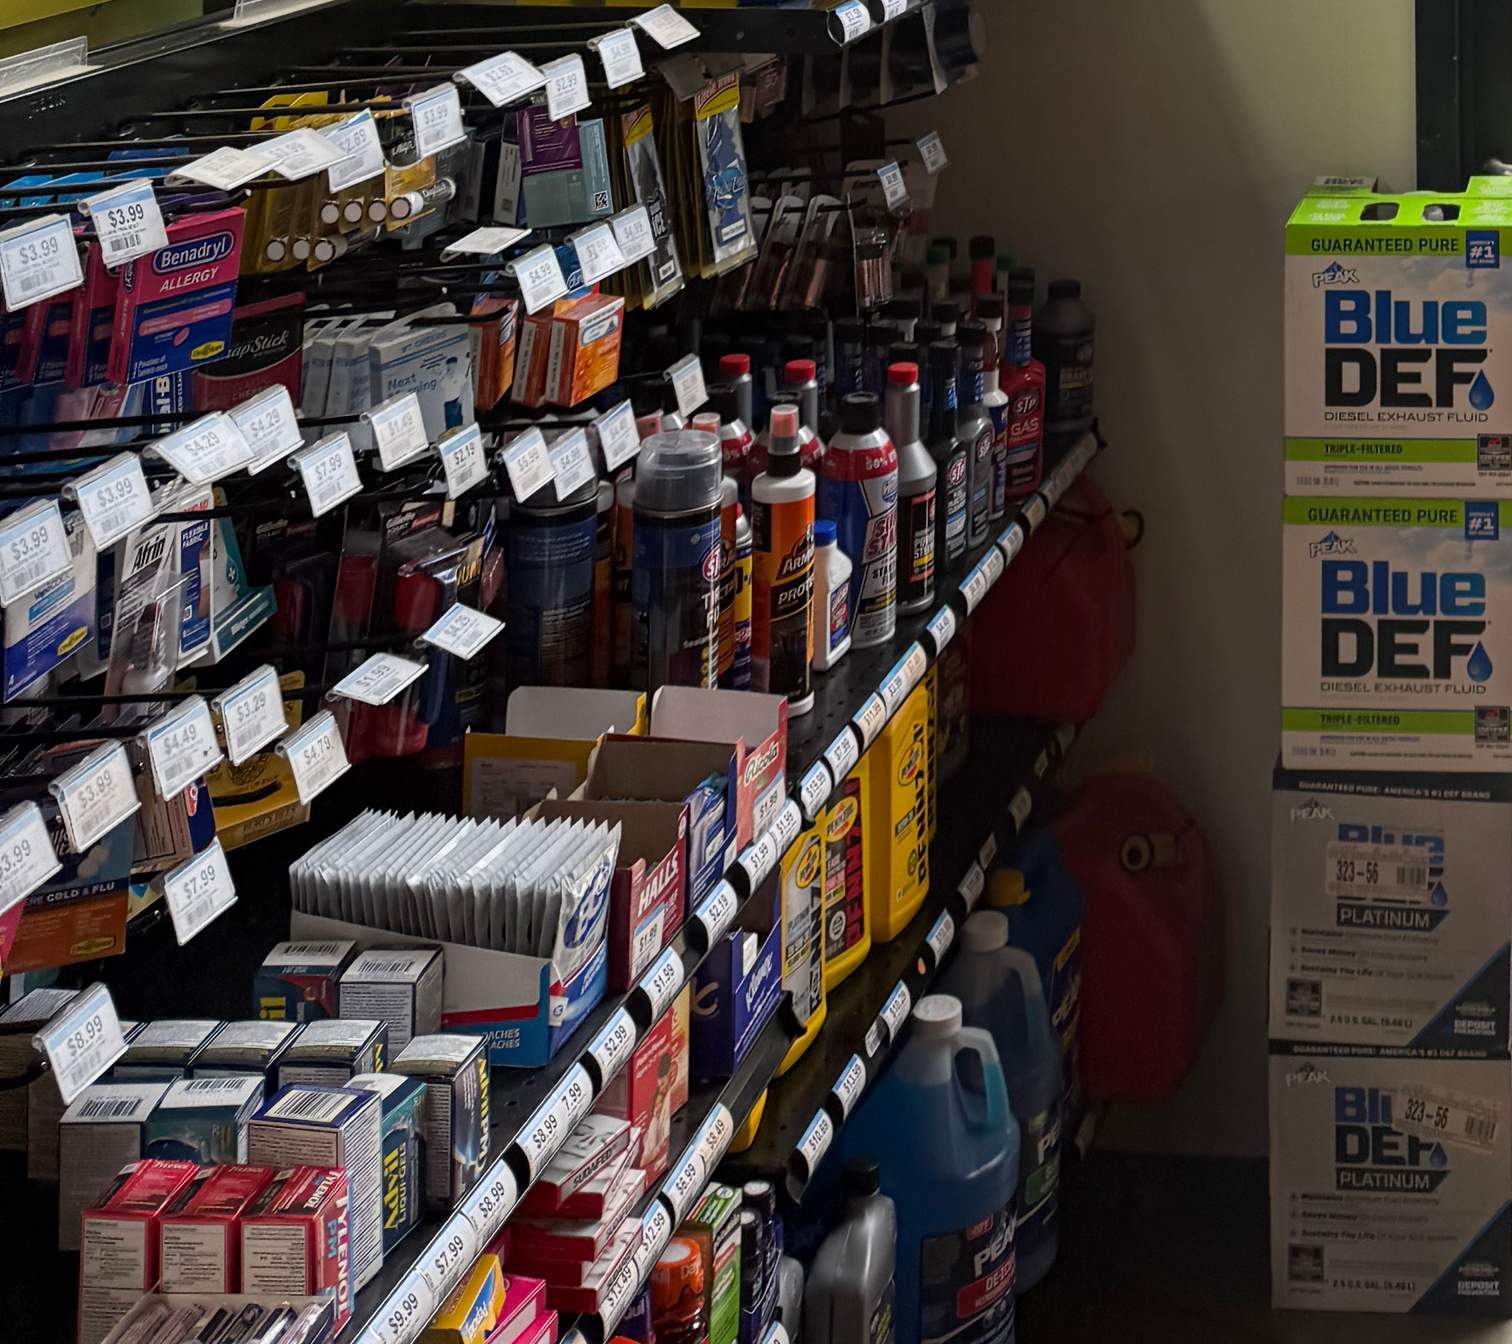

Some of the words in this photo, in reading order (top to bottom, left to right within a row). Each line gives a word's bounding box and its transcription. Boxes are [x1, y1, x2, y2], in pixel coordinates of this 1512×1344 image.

[107, 203, 145, 228] $3.99
[19, 236, 59, 265] $3.99
[161, 238, 226, 267] Benadryl
[1311, 238, 1413, 253] GUARANTEED
[1418, 238, 1459, 252] PURE
[1469, 245, 1495, 259] #1
[159, 266, 219, 293] ALLERGY
[1312, 268, 1360, 288] PEAK
[1324, 290, 1488, 345] Blue
[1324, 348, 1488, 408] DEF
[1324, 411, 1374, 422] DIESEL
[1377, 412, 1444, 423] EXHAUST
[1447, 412, 1489, 423] FLUID
[1324, 444, 1403, 455] TRIPLE-FILTERED
[314, 454, 343, 481] $7.99
[96, 477, 134, 507] $3.99
[1308, 508, 1411, 523] GUARANTEED
[1416, 509, 1458, 524] PURE
[1469, 517, 1495, 530] #1
[10, 526, 49, 561] $3.99
[132, 531, 166, 574] Afrin
[1309, 539, 1358, 558] PEAK
[1321, 559, 1486, 616] Blue
[1321, 618, 1487, 680] DEF
[1320, 682, 1371, 693] DIESEL
[1374, 683, 1441, 694] EXHAUST
[1444, 684, 1487, 694] FLUID
[236, 691, 267, 720] $3.29
[1320, 714, 1401, 726] TRIPLE-FILTERED
[162, 723, 197, 754] $4.49
[744, 741, 780, 787] Ricola
[79, 772, 114, 807] $3.99
[759, 791, 779, 818] $1.99
[775, 811, 795, 836] $1.99
[750, 844, 769, 869] $1.99
[47, 887, 72, 903] COLD
[88, 880, 115, 897] FLU
[182, 865, 217, 898] $7.99
[638, 850, 680, 918] HALLS
[708, 895, 729, 922] $2.19
[1339, 906, 1430, 928] PLATINUM
[653, 963, 676, 993] $1.99
[68, 1015, 103, 1051] $8.99
[604, 1025, 627, 1054] $2.99
[1454, 1020, 1496, 1031] DEPOSIT
[532, 1113, 558, 1150] $8.99
[572, 1148, 613, 1187] SUDAFED
[675, 1162, 697, 1196] $6.99
[1339, 1170, 1430, 1189] PLATINUM
[383, 1147, 401, 1230] Advil
[478, 1181, 506, 1219] $8.99
[326, 1219, 338, 1258] PM
[641, 1212, 665, 1252] $12.99
[335, 1192, 350, 1317] TYLENOL
[434, 1235, 464, 1275] $7.99
[388, 1292, 419, 1335] $9.99
